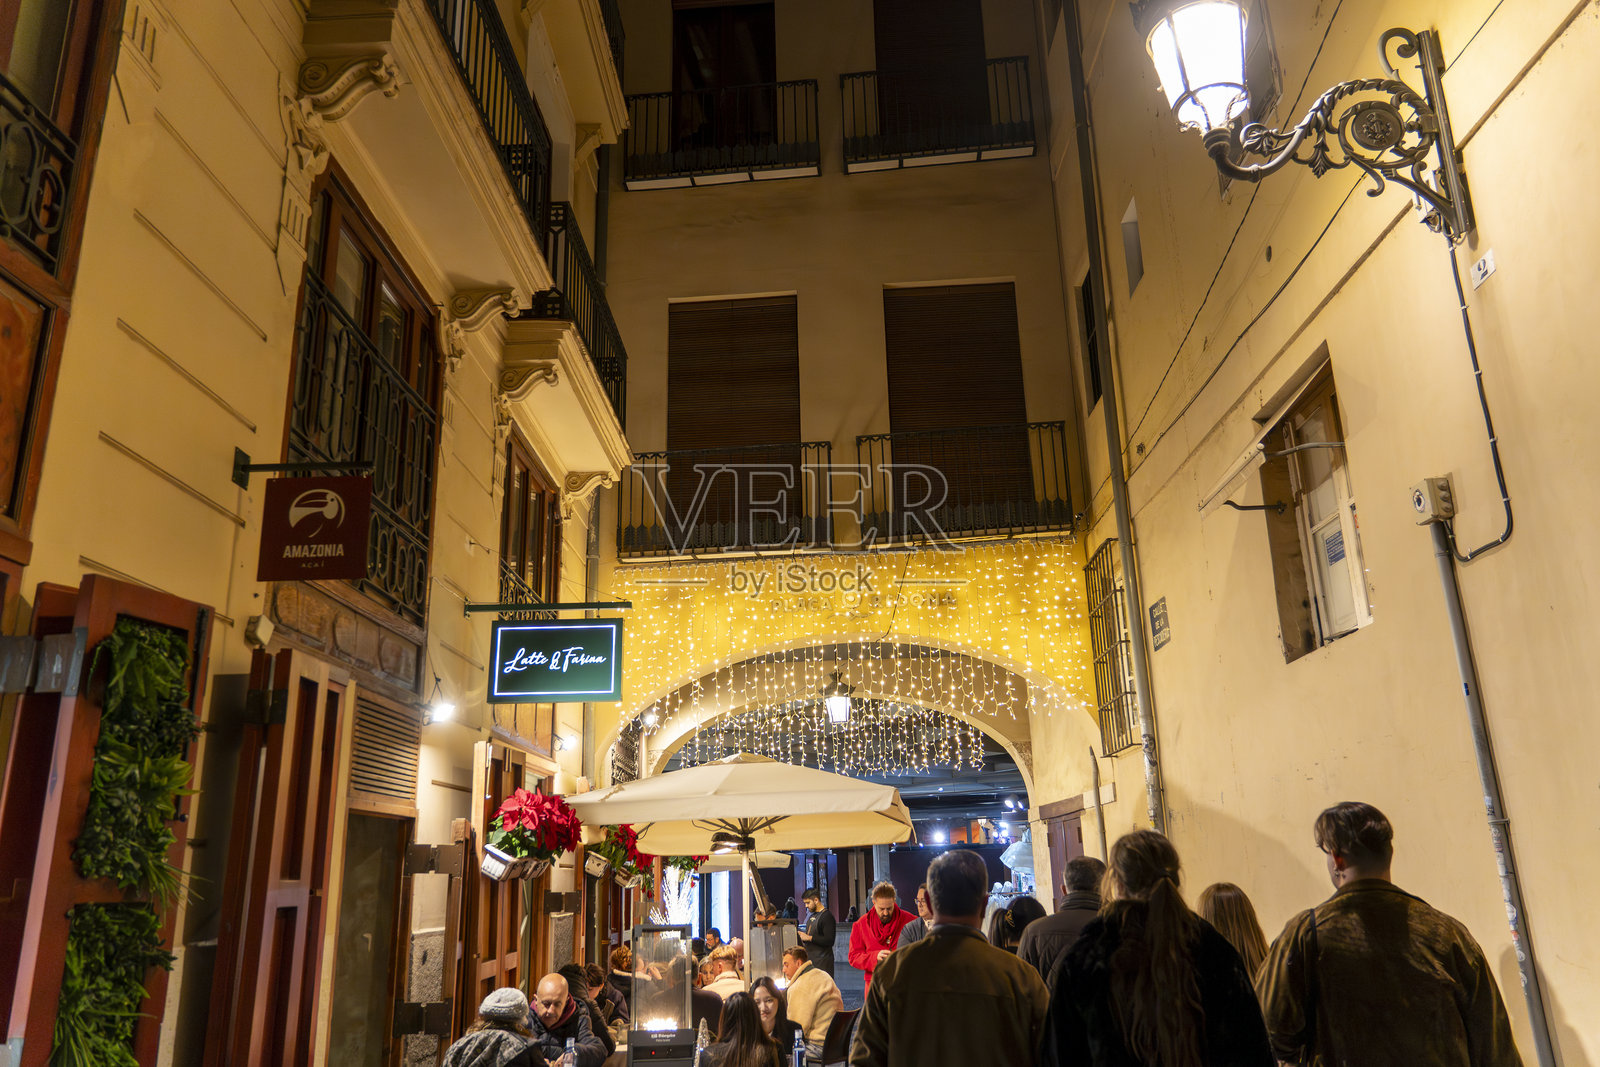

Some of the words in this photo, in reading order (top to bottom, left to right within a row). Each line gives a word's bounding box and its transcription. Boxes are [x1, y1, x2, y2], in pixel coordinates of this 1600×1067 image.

[1477, 259, 1488, 280] 2
[282, 544, 345, 558] AMAZONIA
[503, 647, 549, 674] Latte
[549, 650, 561, 670] &
[562, 646, 607, 673] Farina
